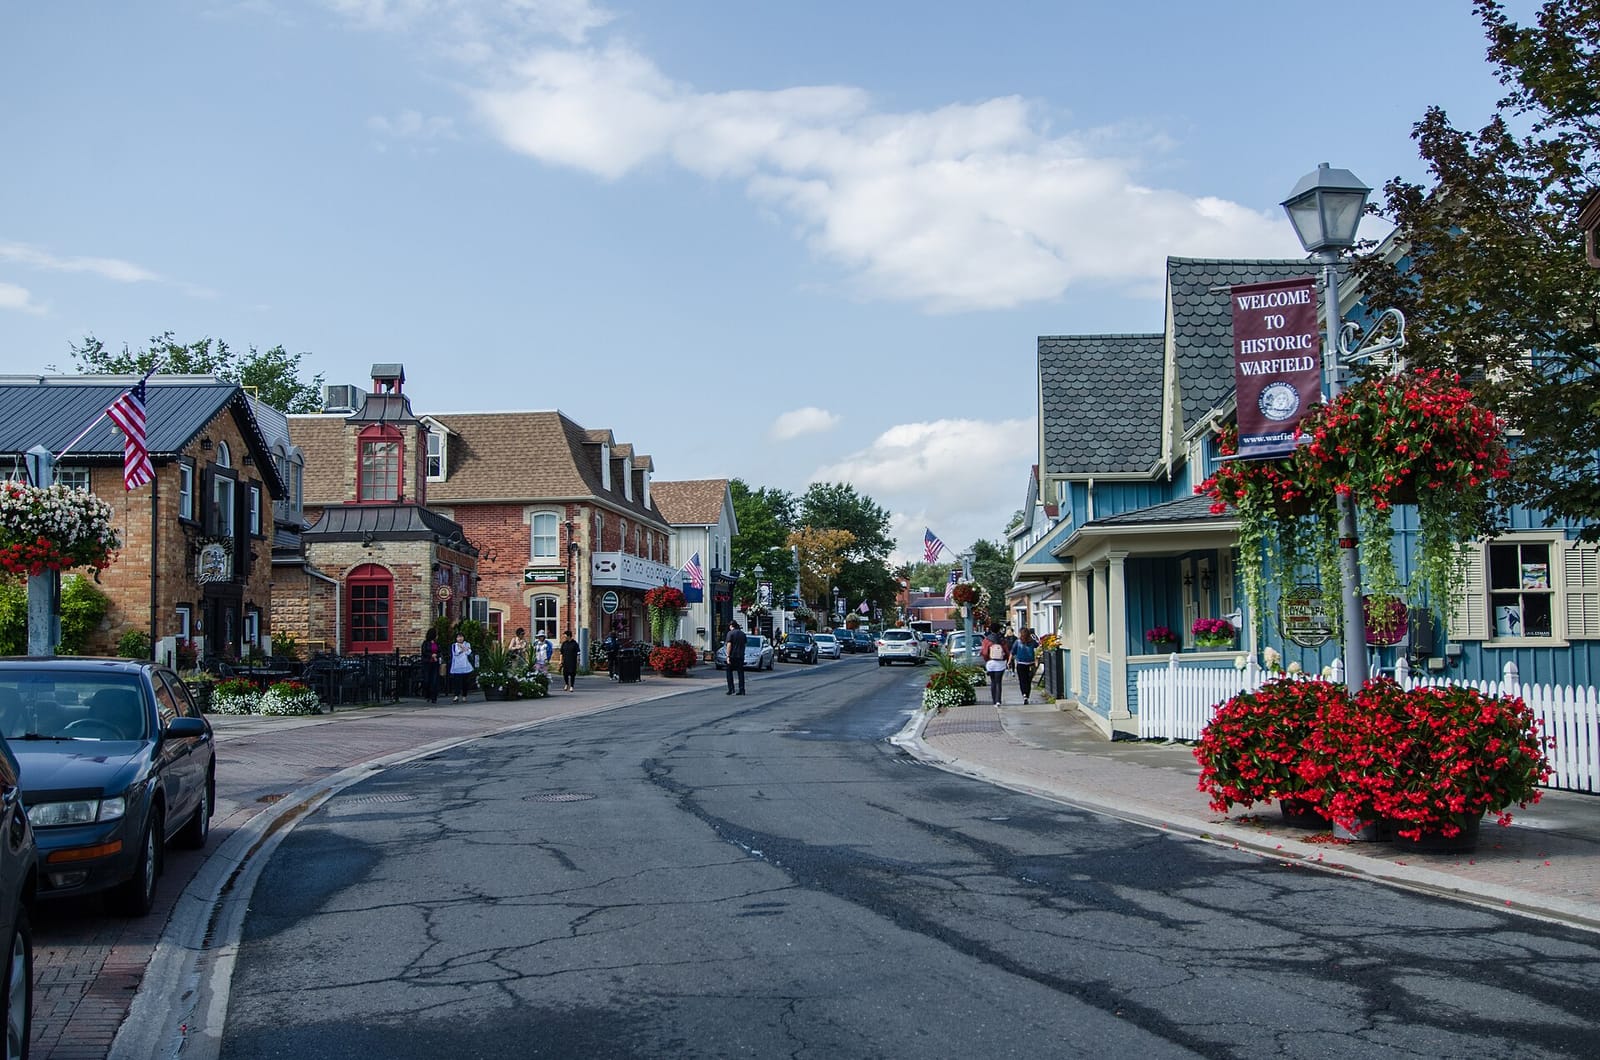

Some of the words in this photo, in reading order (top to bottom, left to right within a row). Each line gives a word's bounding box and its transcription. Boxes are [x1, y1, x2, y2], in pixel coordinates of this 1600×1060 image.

[1237, 290, 1310, 310] WELCOME
[1264, 314, 1285, 330] TO
[1240, 333, 1312, 354] HISTORIC
[1240, 356, 1314, 376] WARFIELD
